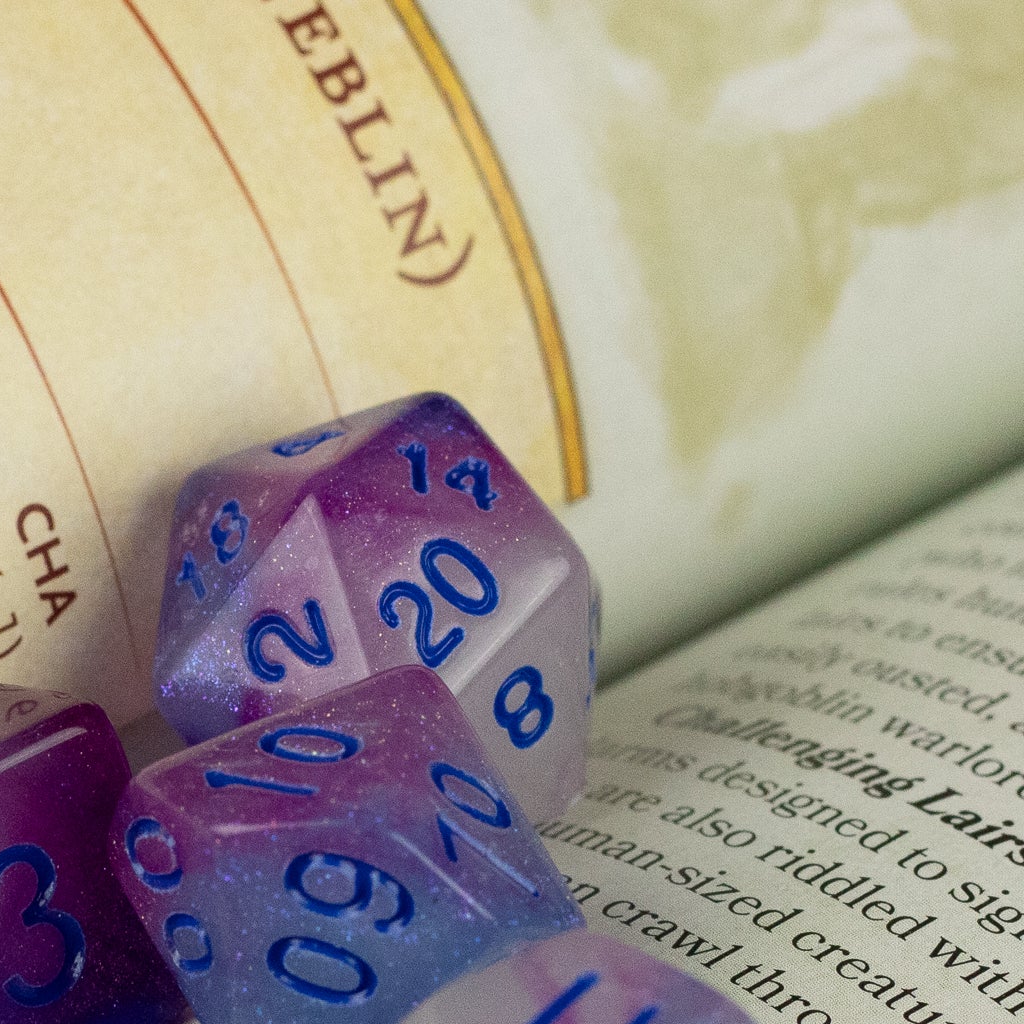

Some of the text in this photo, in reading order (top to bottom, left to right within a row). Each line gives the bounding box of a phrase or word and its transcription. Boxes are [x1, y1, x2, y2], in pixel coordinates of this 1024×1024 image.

[16, 503, 77, 626] CHA
[378, 537, 500, 669] 20
[244, 599, 335, 684] 2
[493, 665, 555, 750] 8
[656, 702, 925, 800] Challenging
[880, 715, 1024, 800] warlor
[659, 802, 757, 850] also
[756, 845, 938, 941] riddled
[696, 759, 1024, 942] designed to sig
[601, 899, 743, 969] crawl
